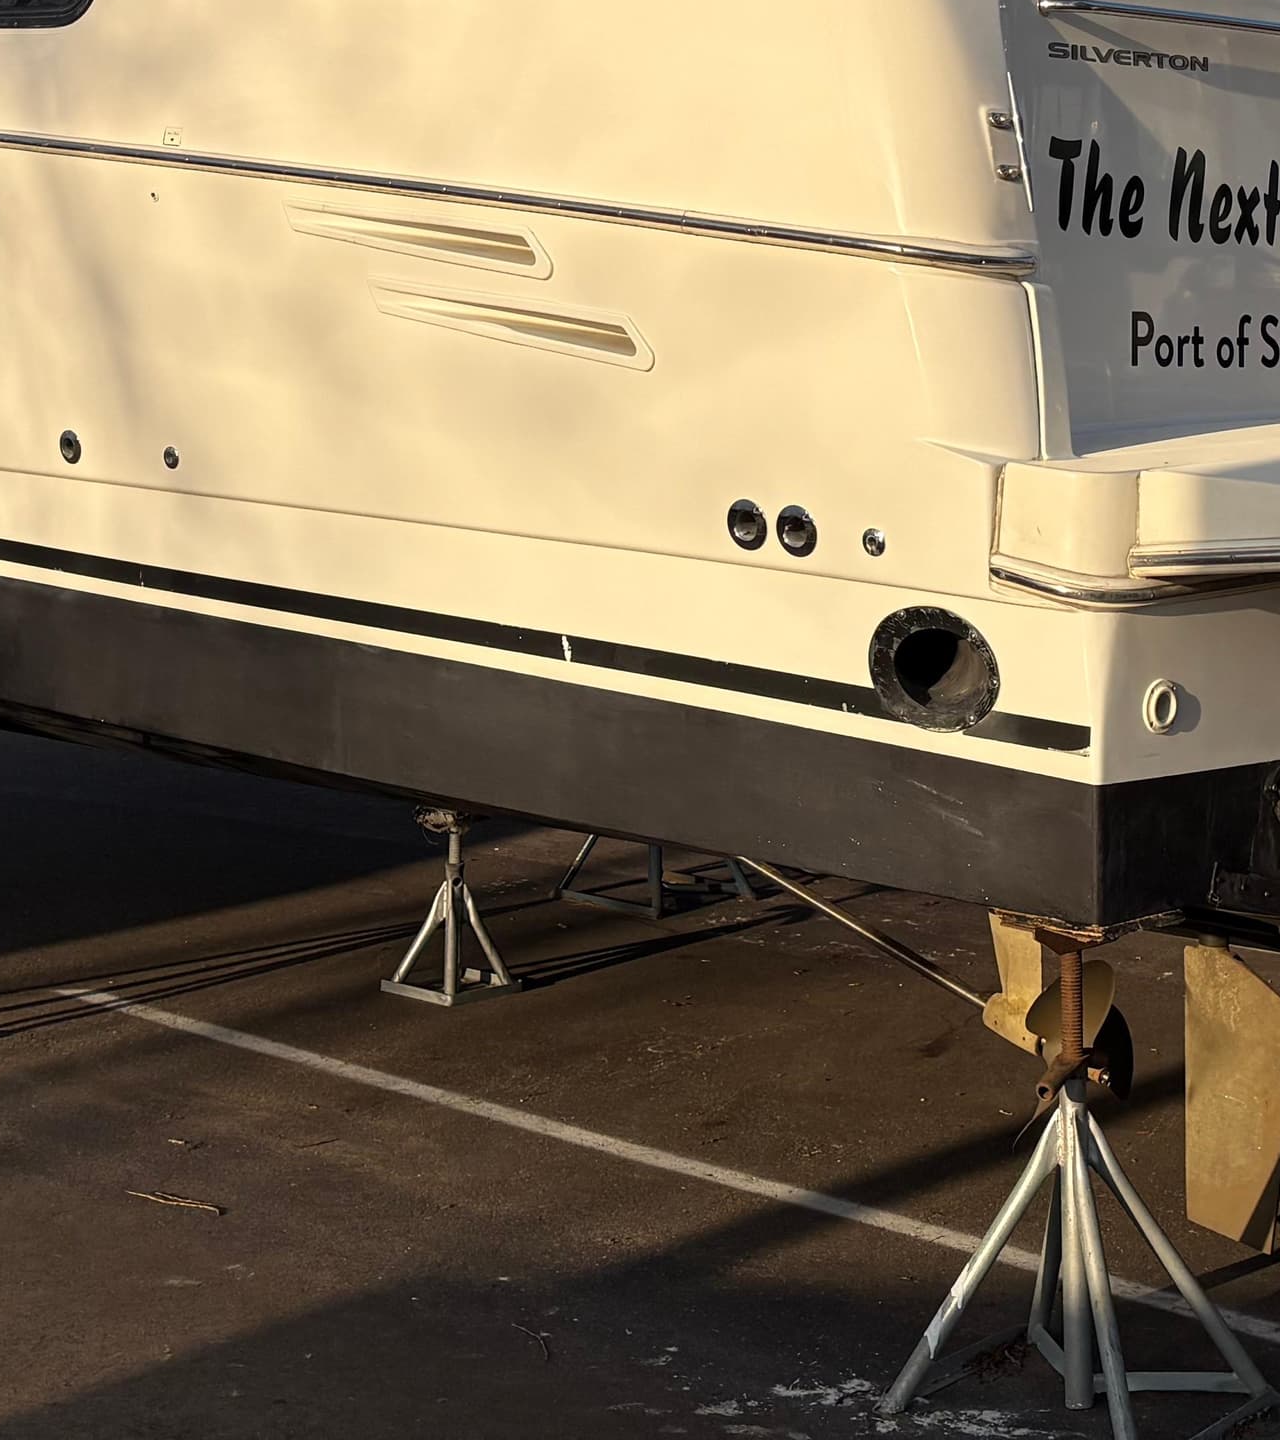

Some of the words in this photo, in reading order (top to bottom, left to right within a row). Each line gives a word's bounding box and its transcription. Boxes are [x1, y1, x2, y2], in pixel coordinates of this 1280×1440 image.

[1047, 42, 1209, 72] SILVERTON
[1048, 135, 1145, 239] The
[1131, 310, 1205, 369] Port
[1216, 313, 1253, 369] of
